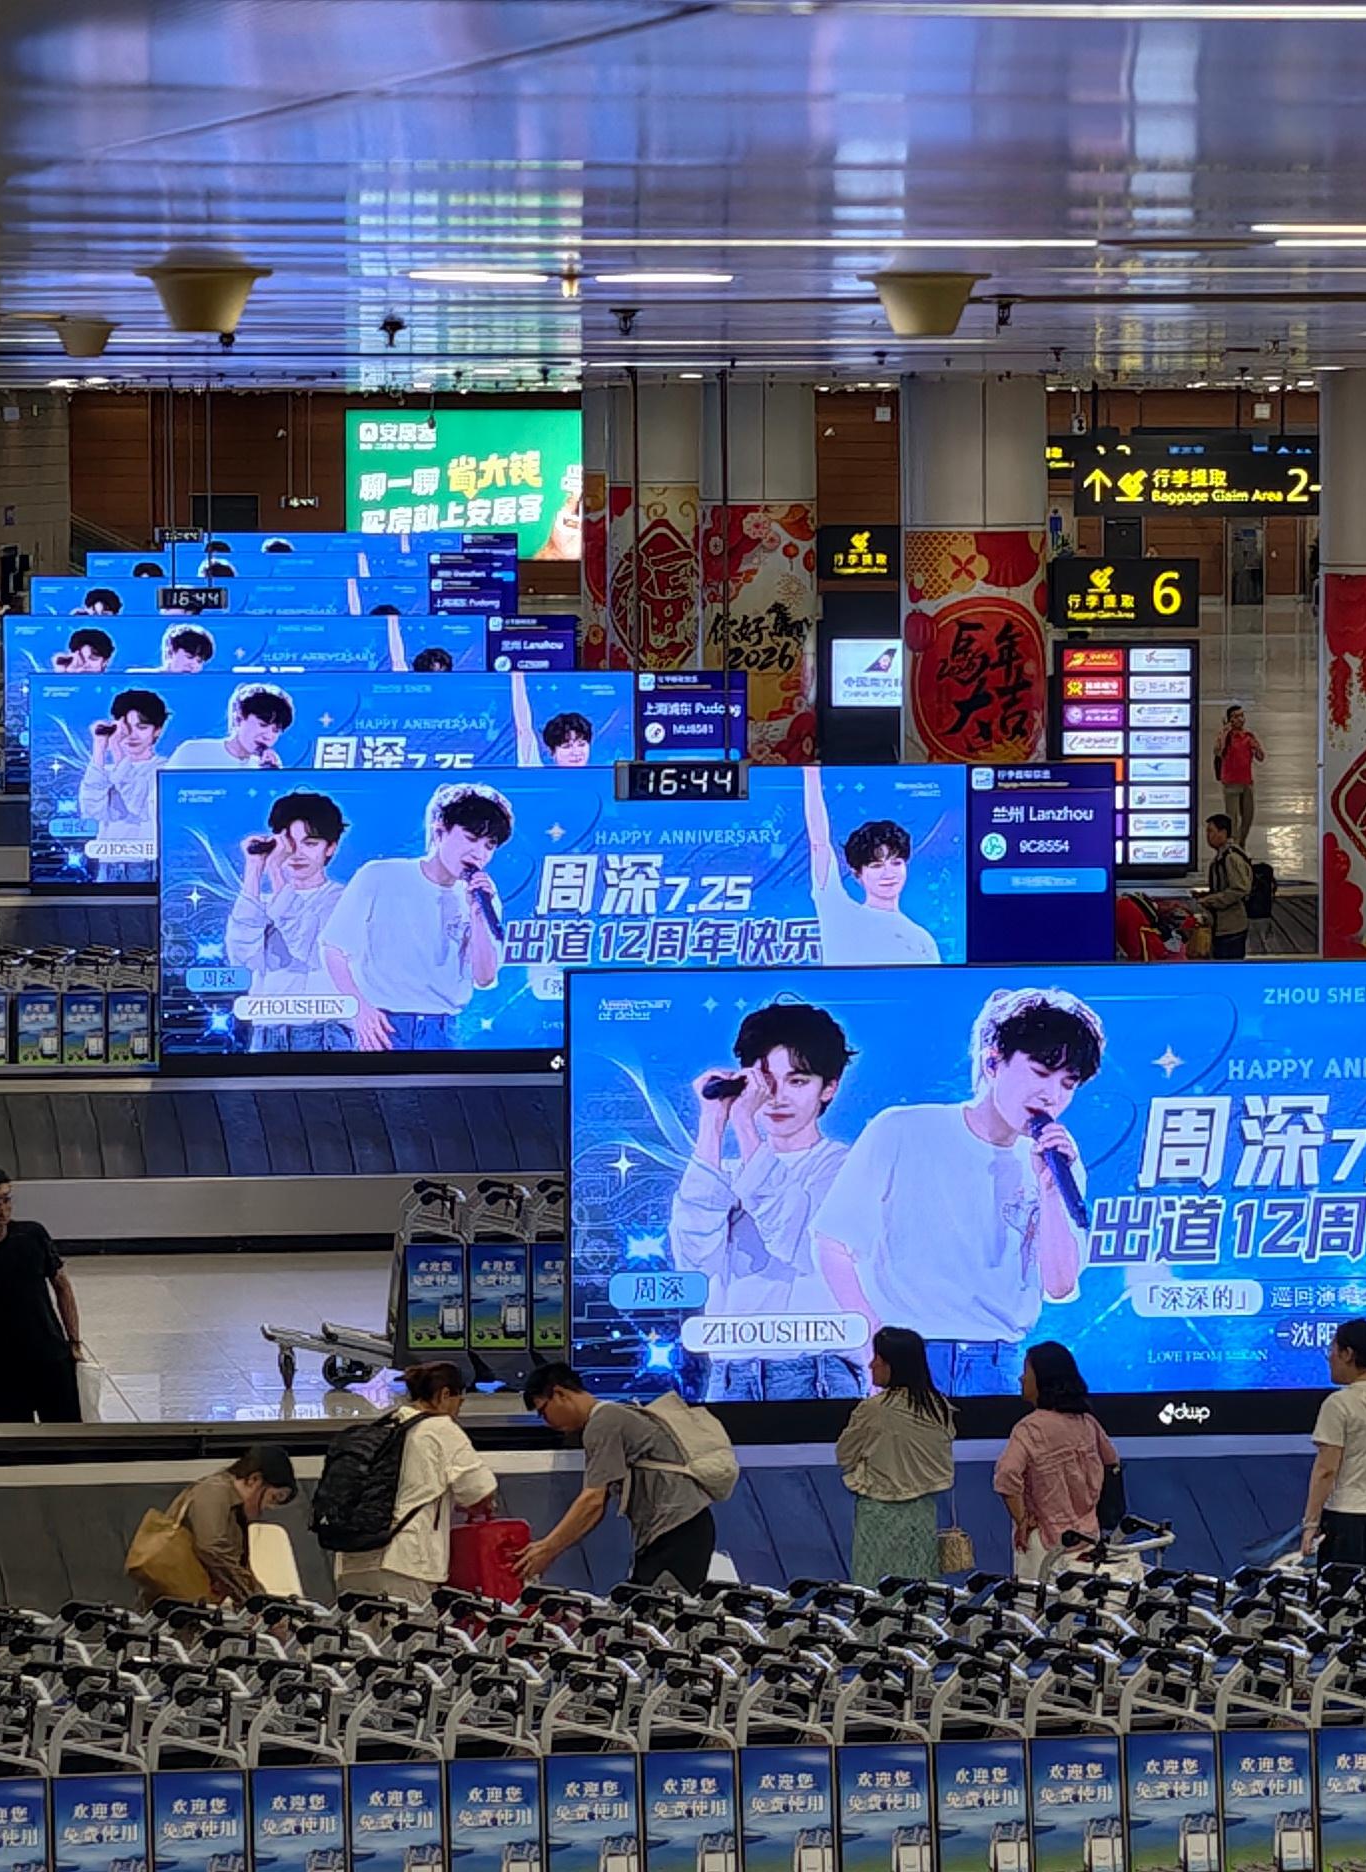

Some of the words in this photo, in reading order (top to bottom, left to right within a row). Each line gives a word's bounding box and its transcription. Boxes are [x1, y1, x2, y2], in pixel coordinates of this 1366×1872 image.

[1152, 468, 1229, 487] 行李提取
[1151, 491, 1209, 505] Baggage
[1067, 594, 1136, 608] 行李提取
[1152, 570, 1182, 616] 6
[727, 642, 796, 673] 2026
[645, 769, 733, 796] 16:44
[991, 805, 1025, 824] 兰州
[1029, 805, 1095, 822] Lanzhou
[595, 829, 652, 846] HAPPY
[658, 827, 783, 847] ANNIVERSARY
[502, 917, 822, 966] 出道12周年快乐
[1263, 986, 1321, 1005] ZHOU
[247, 999, 345, 1017] ZHOUSHEN
[1227, 1058, 1314, 1081] HAPPY
[636, 1276, 686, 1301] 周深
[1146, 1285, 1248, 1312] 「深深的」
[702, 1320, 848, 1344] ZHOUSHEN
[1048, 1762, 1105, 1781] 欢迎您
[1144, 1758, 1202, 1776] 欢迎您
[1238, 1755, 1296, 1774] 欢迎您
[758, 1772, 817, 1791] 欢迎您
[857, 1769, 915, 1789] 欢迎您
[954, 1766, 1010, 1785] 欢迎您
[466, 1785, 525, 1804] 欢迎您
[564, 1780, 622, 1799] 欢迎您
[661, 1776, 720, 1796] 欢迎您
[171, 1796, 228, 1816] 欢迎您
[270, 1793, 329, 1813] 欢迎您
[366, 1788, 425, 1808] 欢迎您
[73, 1801, 130, 1821] 欢迎您
